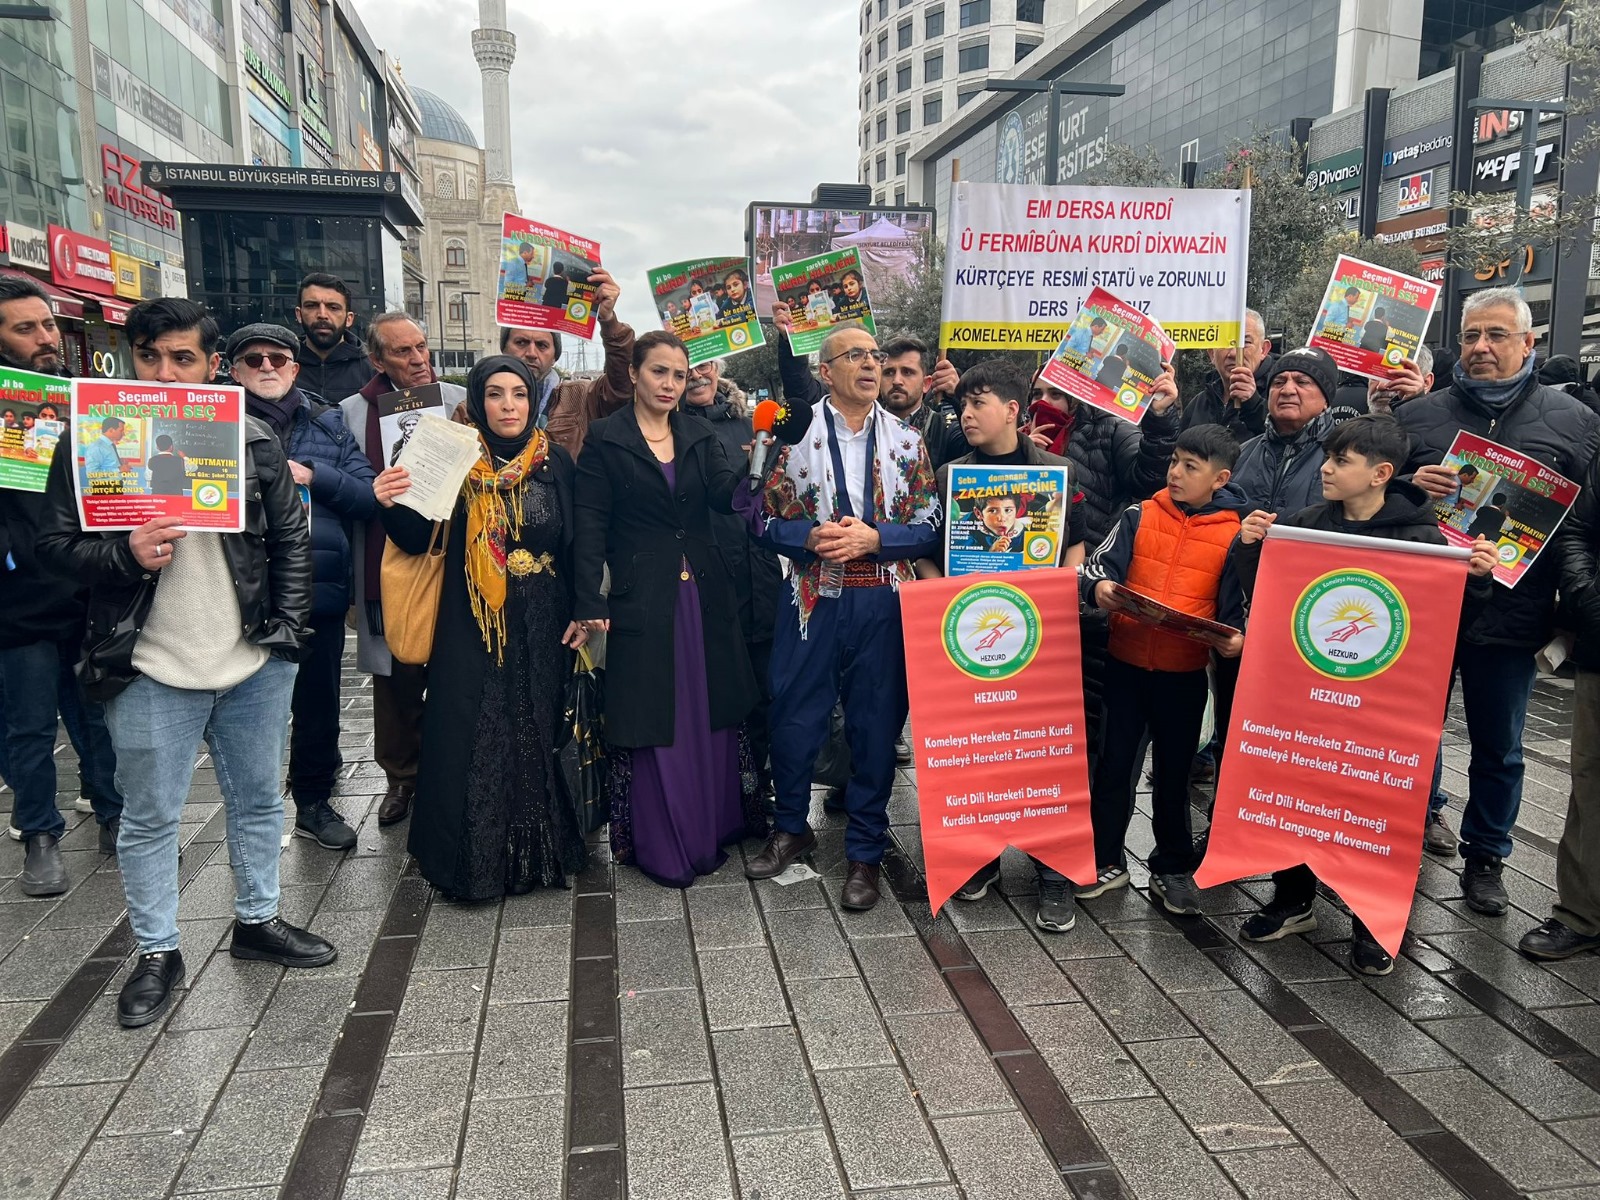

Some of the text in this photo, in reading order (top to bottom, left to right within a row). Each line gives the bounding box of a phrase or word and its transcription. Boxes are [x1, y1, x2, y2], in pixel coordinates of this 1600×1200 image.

[116, 71, 142, 115] MİR
[1024, 106, 1089, 166] ESEURT
[1392, 135, 1452, 165] yataş bedding
[1476, 143, 1554, 182] MACFT
[165, 166, 380, 188] İSTANBUL BÜYÜKŞEHİR BELEDİYESİ
[1400, 181, 1429, 202] D&R
[1026, 197, 1174, 221] EM DERSA KURDÎ
[529, 224, 593, 250] Seçmeli Derste
[960, 228, 974, 251] Û
[978, 232, 1083, 254] FERMÎBÛNA
[1088, 230, 1143, 254] KURDÎ
[785, 272, 793, 281] bo
[955, 266, 1226, 290] KÜRTÇEYE RESMİ STATÜ ve ZORUNLU
[1361, 270, 1428, 295] Seçmeli Derste
[1028, 300, 1068, 317] DERS
[1111, 303, 1143, 324] Seçmeli
[952, 328, 1022, 344] KOMELEYA
[1165, 325, 1220, 343] DERNEĞİ
[1, 379, 11, 388] Ji
[12, 380, 24, 389] bo
[117, 390, 226, 404] Seçmeli Derste
[88, 400, 216, 423] KÜRDÇEYİ SEÇ
[1341, 405, 1361, 418] KUVVE
[1484, 447, 1569, 488] Seçmeli Derste
[957, 476, 977, 485] Seba
[1527, 477, 1557, 499] SEÇ
[980, 653, 1007, 662] HEZKURD
[1328, 648, 1359, 660] HEZKURD
[1334, 665, 1347, 674] 2020
[973, 690, 1018, 704] HEZKURD
[1309, 687, 1361, 708] HEZKURD
[924, 723, 1073, 750] Komeleya Hereketa Zimanê Kurdî
[1242, 719, 1420, 768] Komeleya Hereketa Zimanê Kurdî
[927, 743, 1073, 770] Komeleyê Hereketê Ziwanê Kurdî
[1239, 740, 1414, 791] Komeleyê Hereketê Ziwanê Kurdî
[946, 784, 1061, 807] Kürd Dili Hareketi Derneği
[942, 804, 1068, 828] Kurdish Language Movement
[1248, 787, 1387, 833] Kürd Dili Hareketi Derneği
[1237, 807, 1391, 857] Kurdish Language Movement
